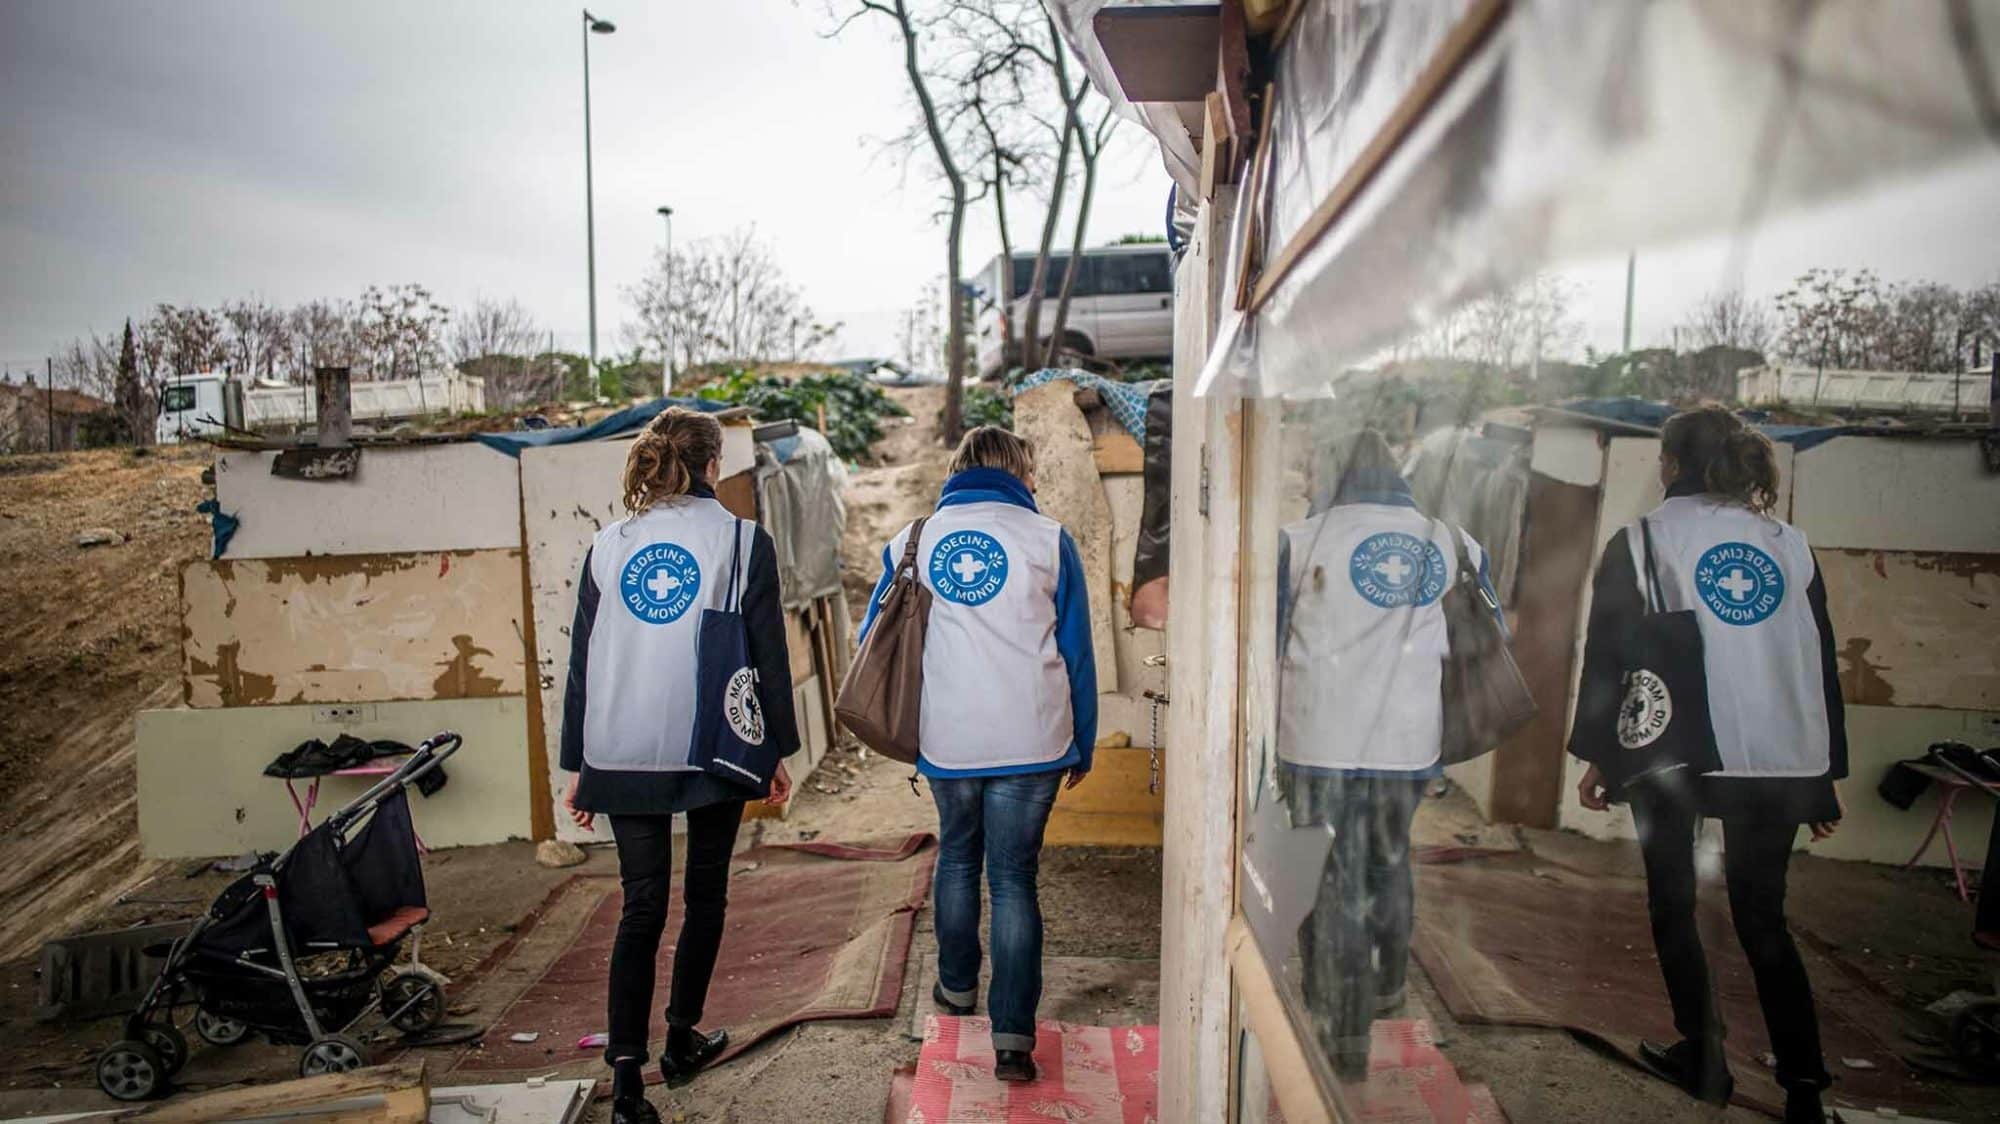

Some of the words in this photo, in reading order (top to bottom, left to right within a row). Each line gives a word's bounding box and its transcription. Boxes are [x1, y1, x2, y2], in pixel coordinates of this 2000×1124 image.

[937, 577, 954, 595] DU
[955, 575, 1001, 602] MONDE
[628, 592, 647, 612] DU
[647, 591, 692, 619] MONDE
[729, 706, 742, 726] DU
